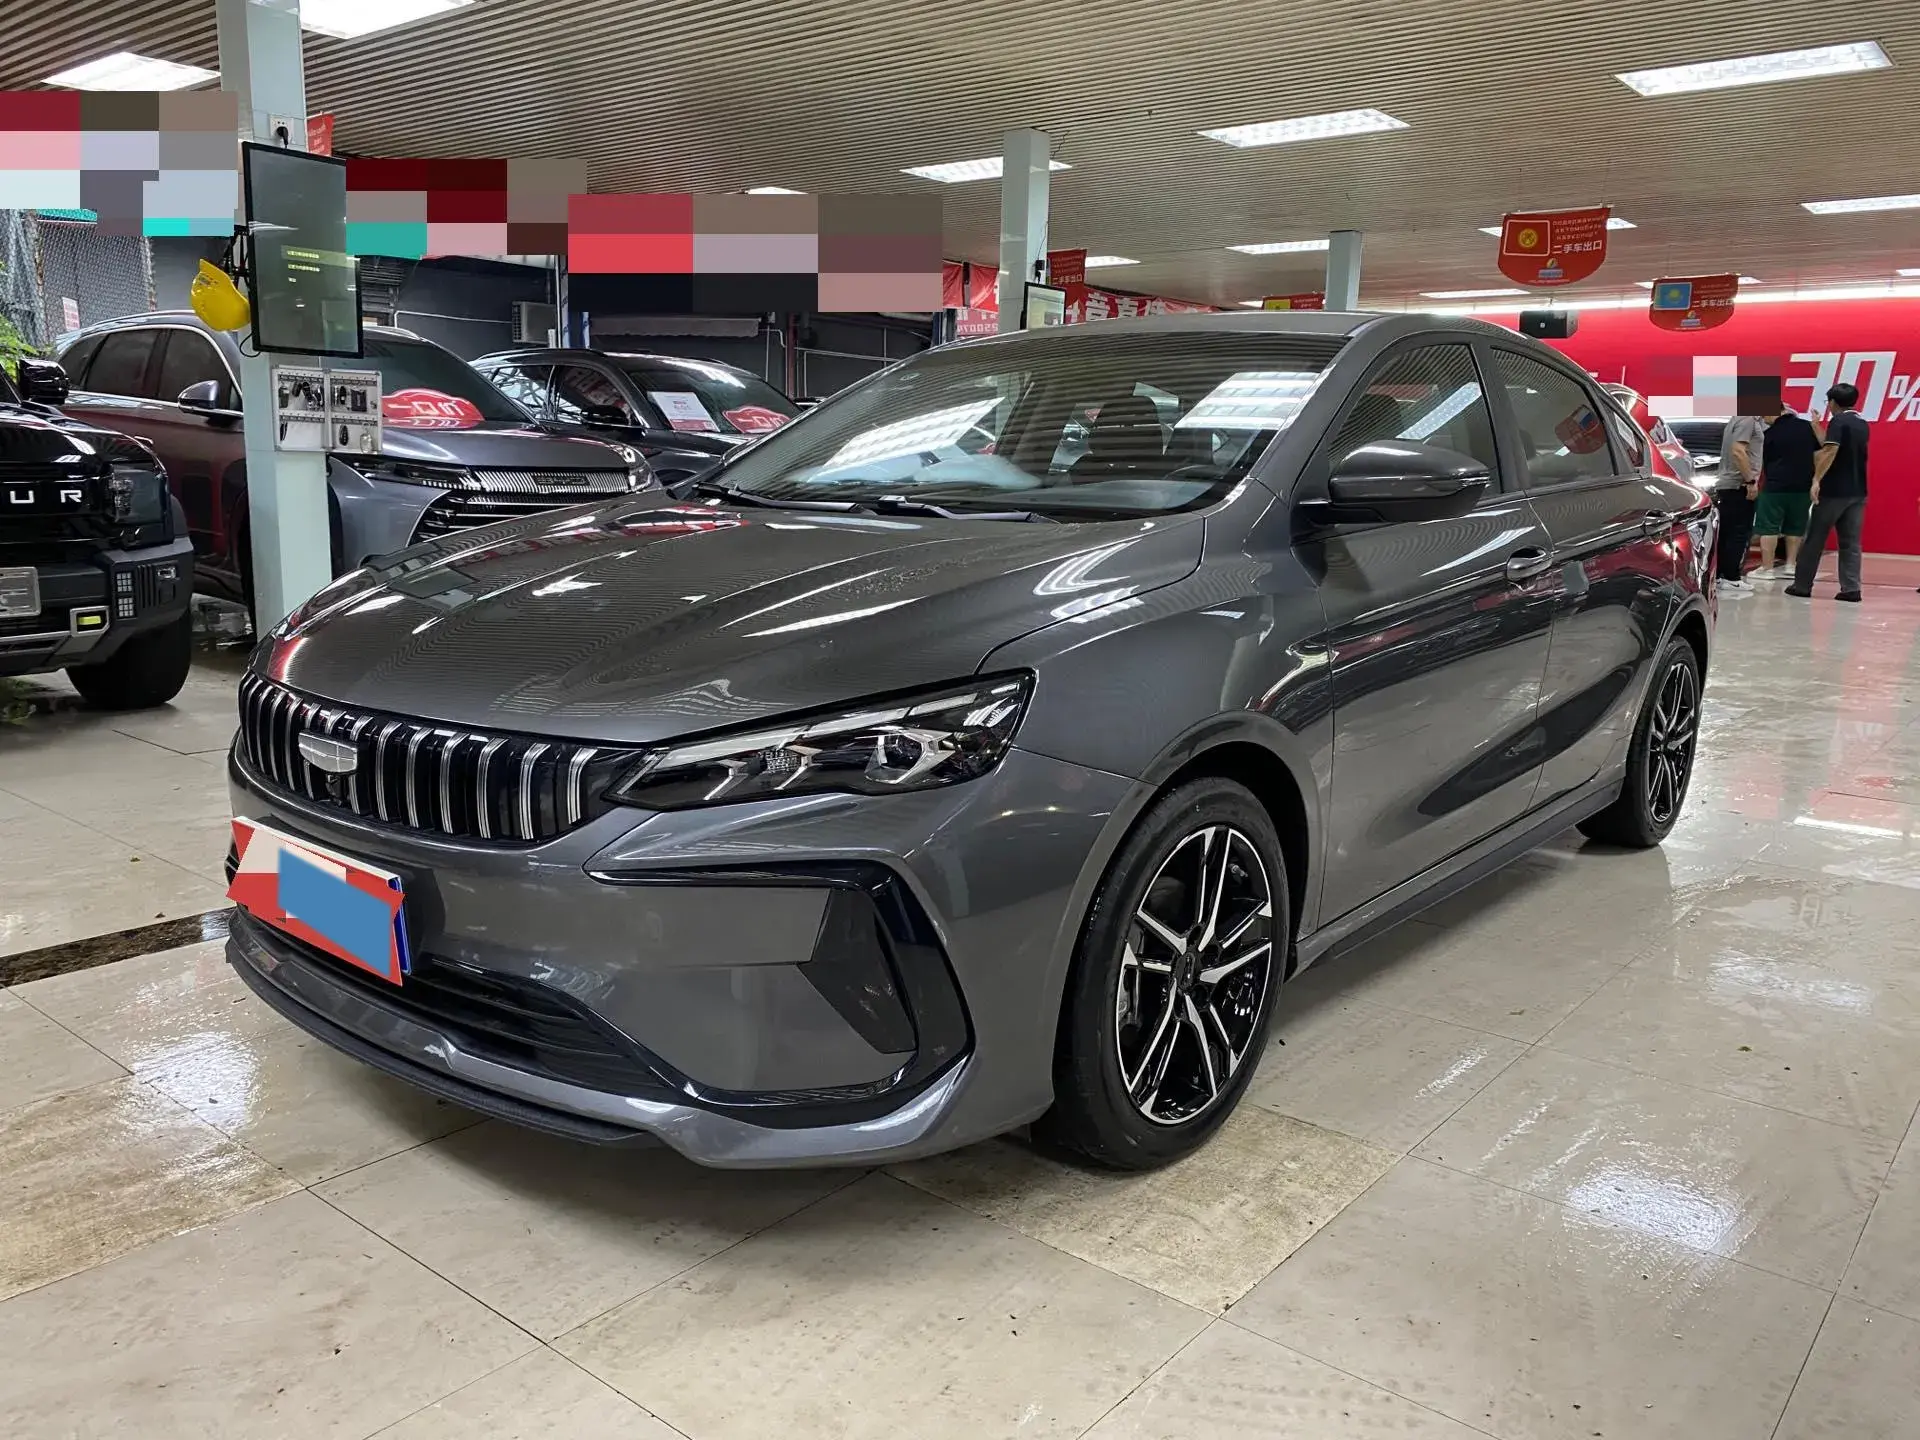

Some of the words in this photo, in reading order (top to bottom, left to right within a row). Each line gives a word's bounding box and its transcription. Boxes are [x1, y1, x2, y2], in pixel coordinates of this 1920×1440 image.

[1552, 240, 1602, 254] 二手车出口
[1692, 298, 1733, 308] 二手车出口
[1785, 351, 1920, 422] 30%
